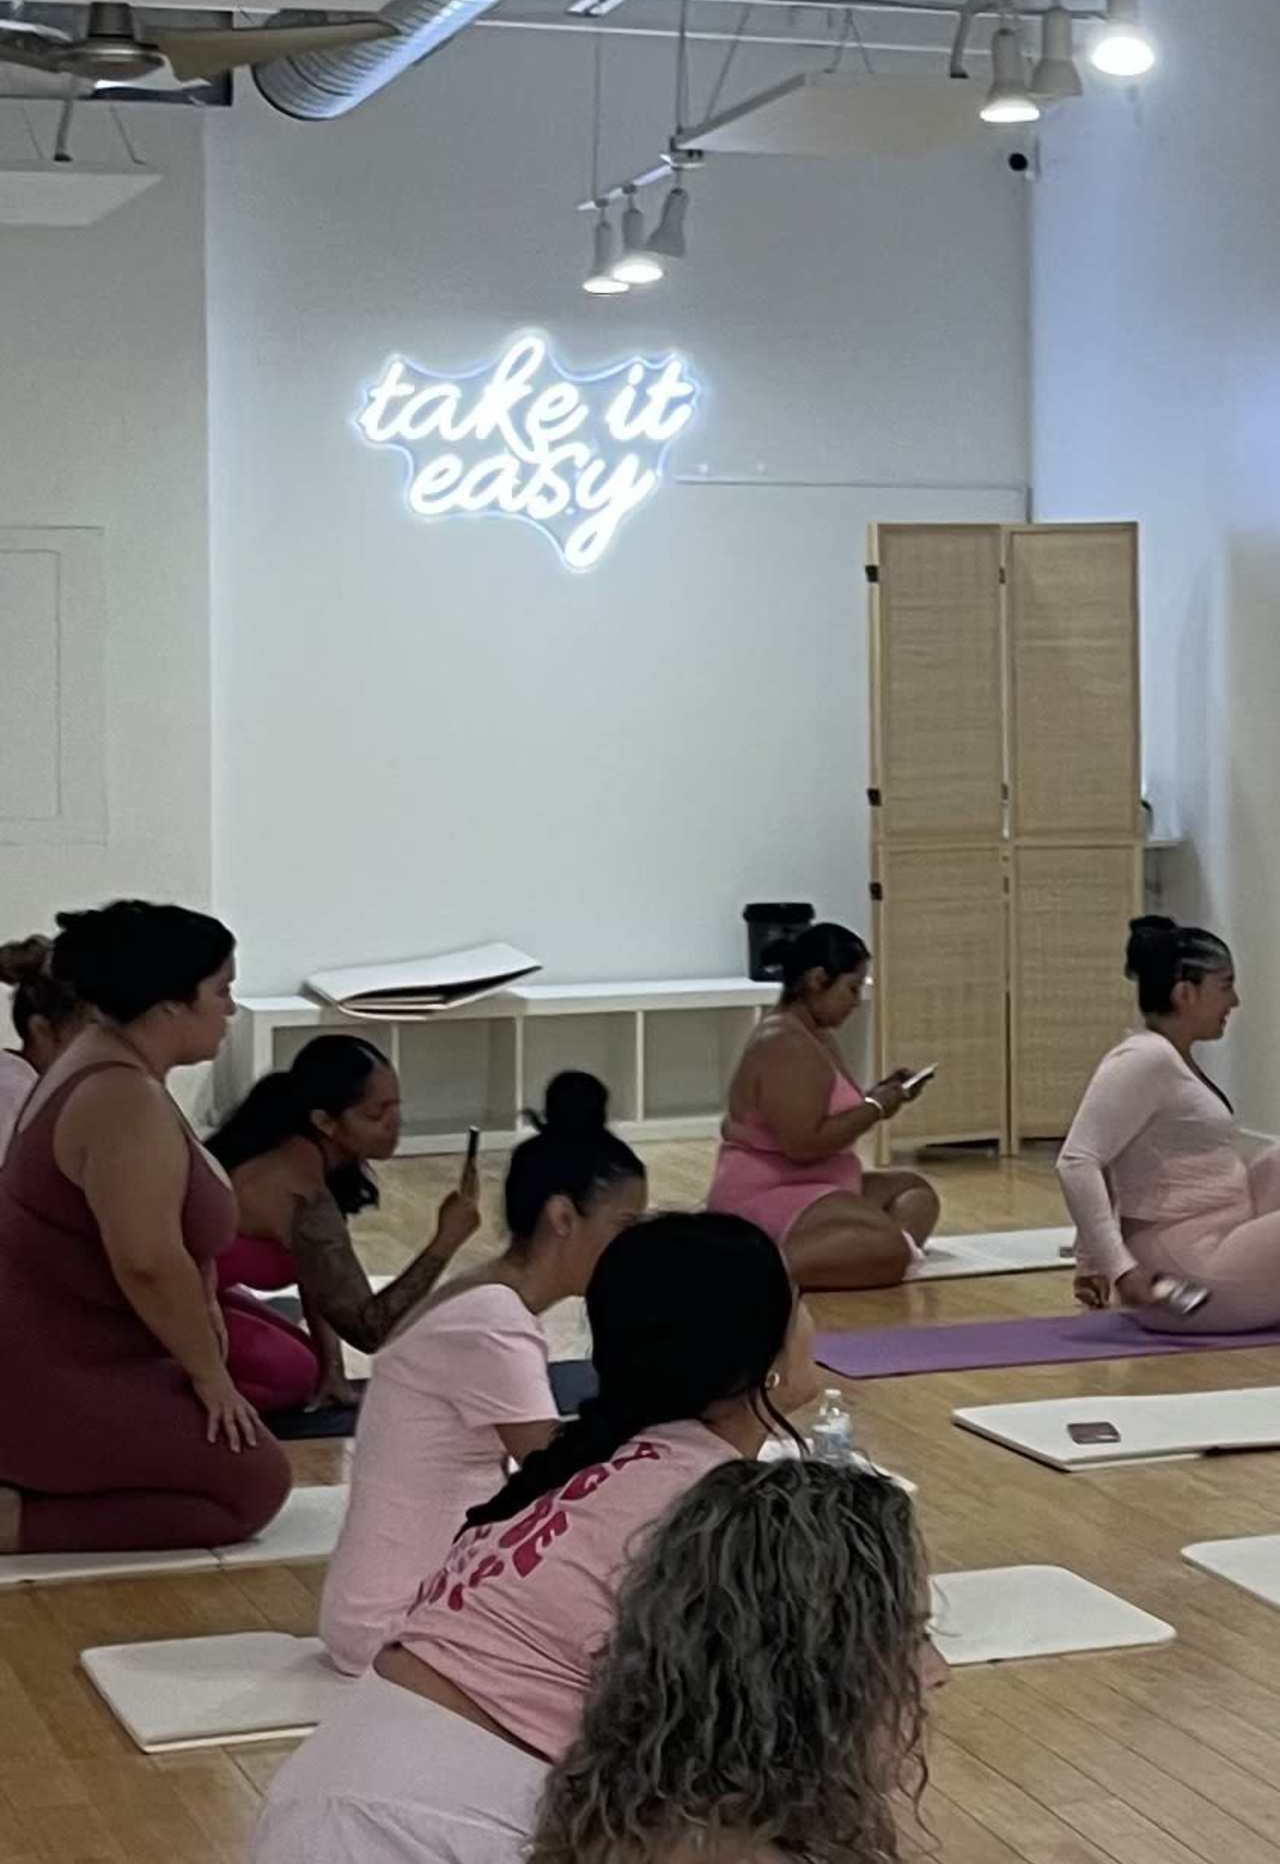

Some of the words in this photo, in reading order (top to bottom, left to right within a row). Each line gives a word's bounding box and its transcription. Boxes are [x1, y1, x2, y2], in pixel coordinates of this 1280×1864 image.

[359, 335, 589, 465] take
[605, 359, 695, 441] it
[409, 438, 659, 568] easy
